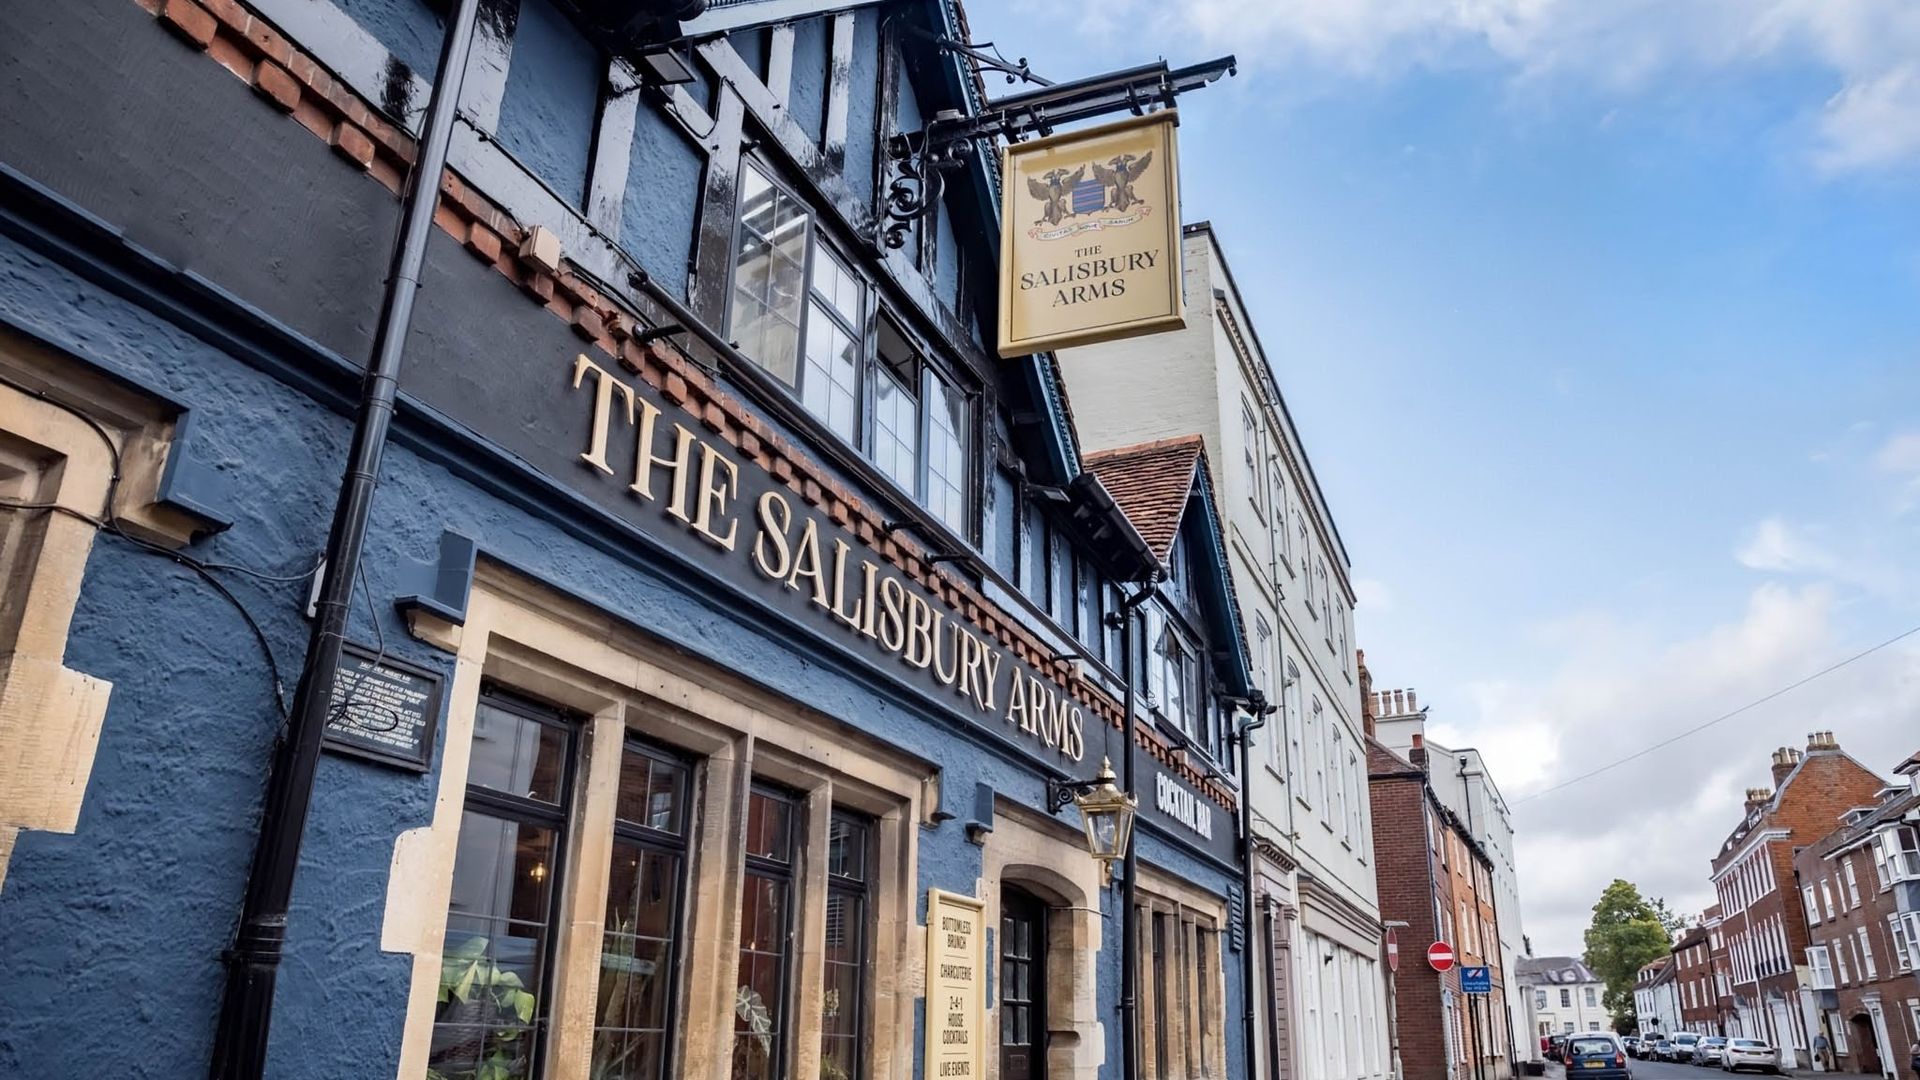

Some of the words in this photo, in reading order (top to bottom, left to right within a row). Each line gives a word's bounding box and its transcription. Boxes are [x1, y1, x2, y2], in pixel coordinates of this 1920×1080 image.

[1043, 227, 1073, 238] CIVITAS
[1074, 245, 1102, 258] THE
[1020, 249, 1159, 291] SALISBURY
[1052, 278, 1126, 308] ARMS
[573, 353, 739, 552] THE
[752, 491, 1001, 711] SALISBURY
[1005, 665, 1084, 762] ARMS
[1156, 771, 1197, 831] COCKTAIL
[1196, 799, 1213, 841] BAR
[941, 916, 971, 935] BOTTOMLESS
[947, 933, 967, 950] BRUNCH
[940, 963, 972, 981] CHARCUTERIE
[949, 996, 963, 1010] 2-4-1
[947, 1012, 964, 1028] HOUSE
[942, 1029, 968, 1044] COCKTAILS
[939, 1061, 951, 1077] LIVE
[951, 1061, 970, 1076] EVENTS
